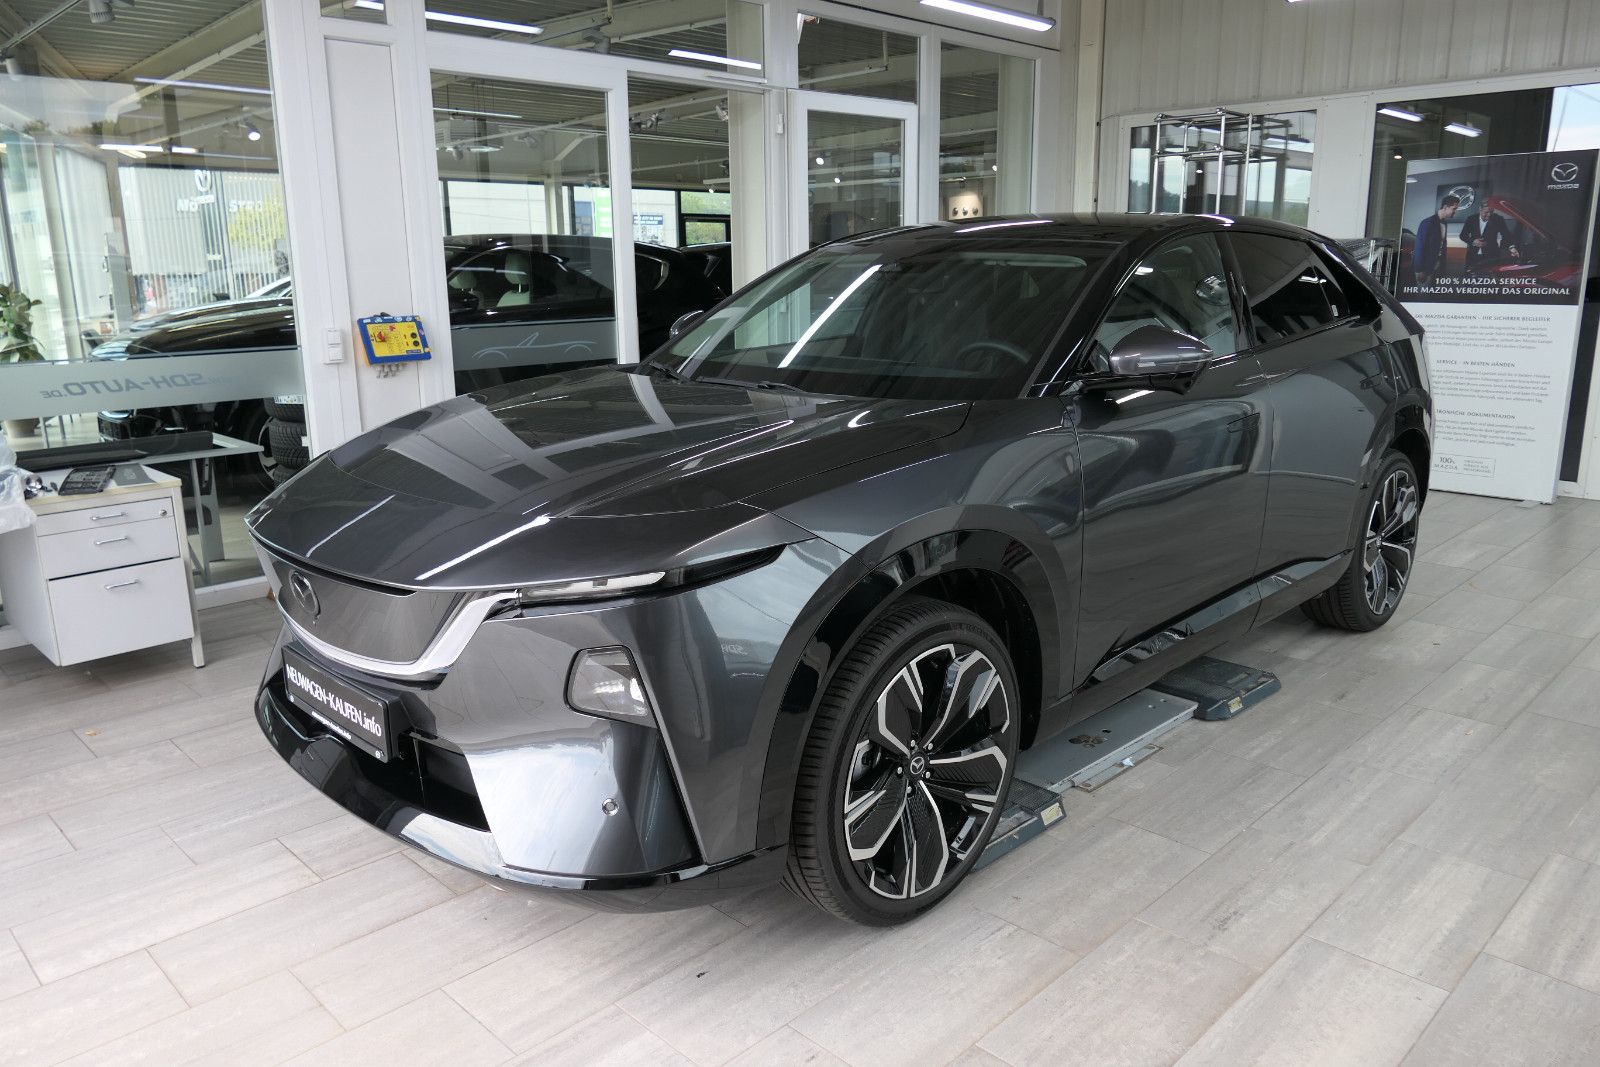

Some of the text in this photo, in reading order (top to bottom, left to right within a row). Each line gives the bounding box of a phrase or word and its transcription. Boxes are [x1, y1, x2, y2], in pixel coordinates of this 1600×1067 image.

[1435, 277, 1451, 285] 100
[1462, 277, 1496, 285] MAZDA
[1499, 277, 1537, 285] SERVICE
[1456, 287, 1499, 295] VERDIENT
[1502, 287, 1521, 295] DAS
[1523, 287, 1570, 295] ORIGINAL
[286, 663, 382, 737] NEUWAGEN-KAUFEN.info
